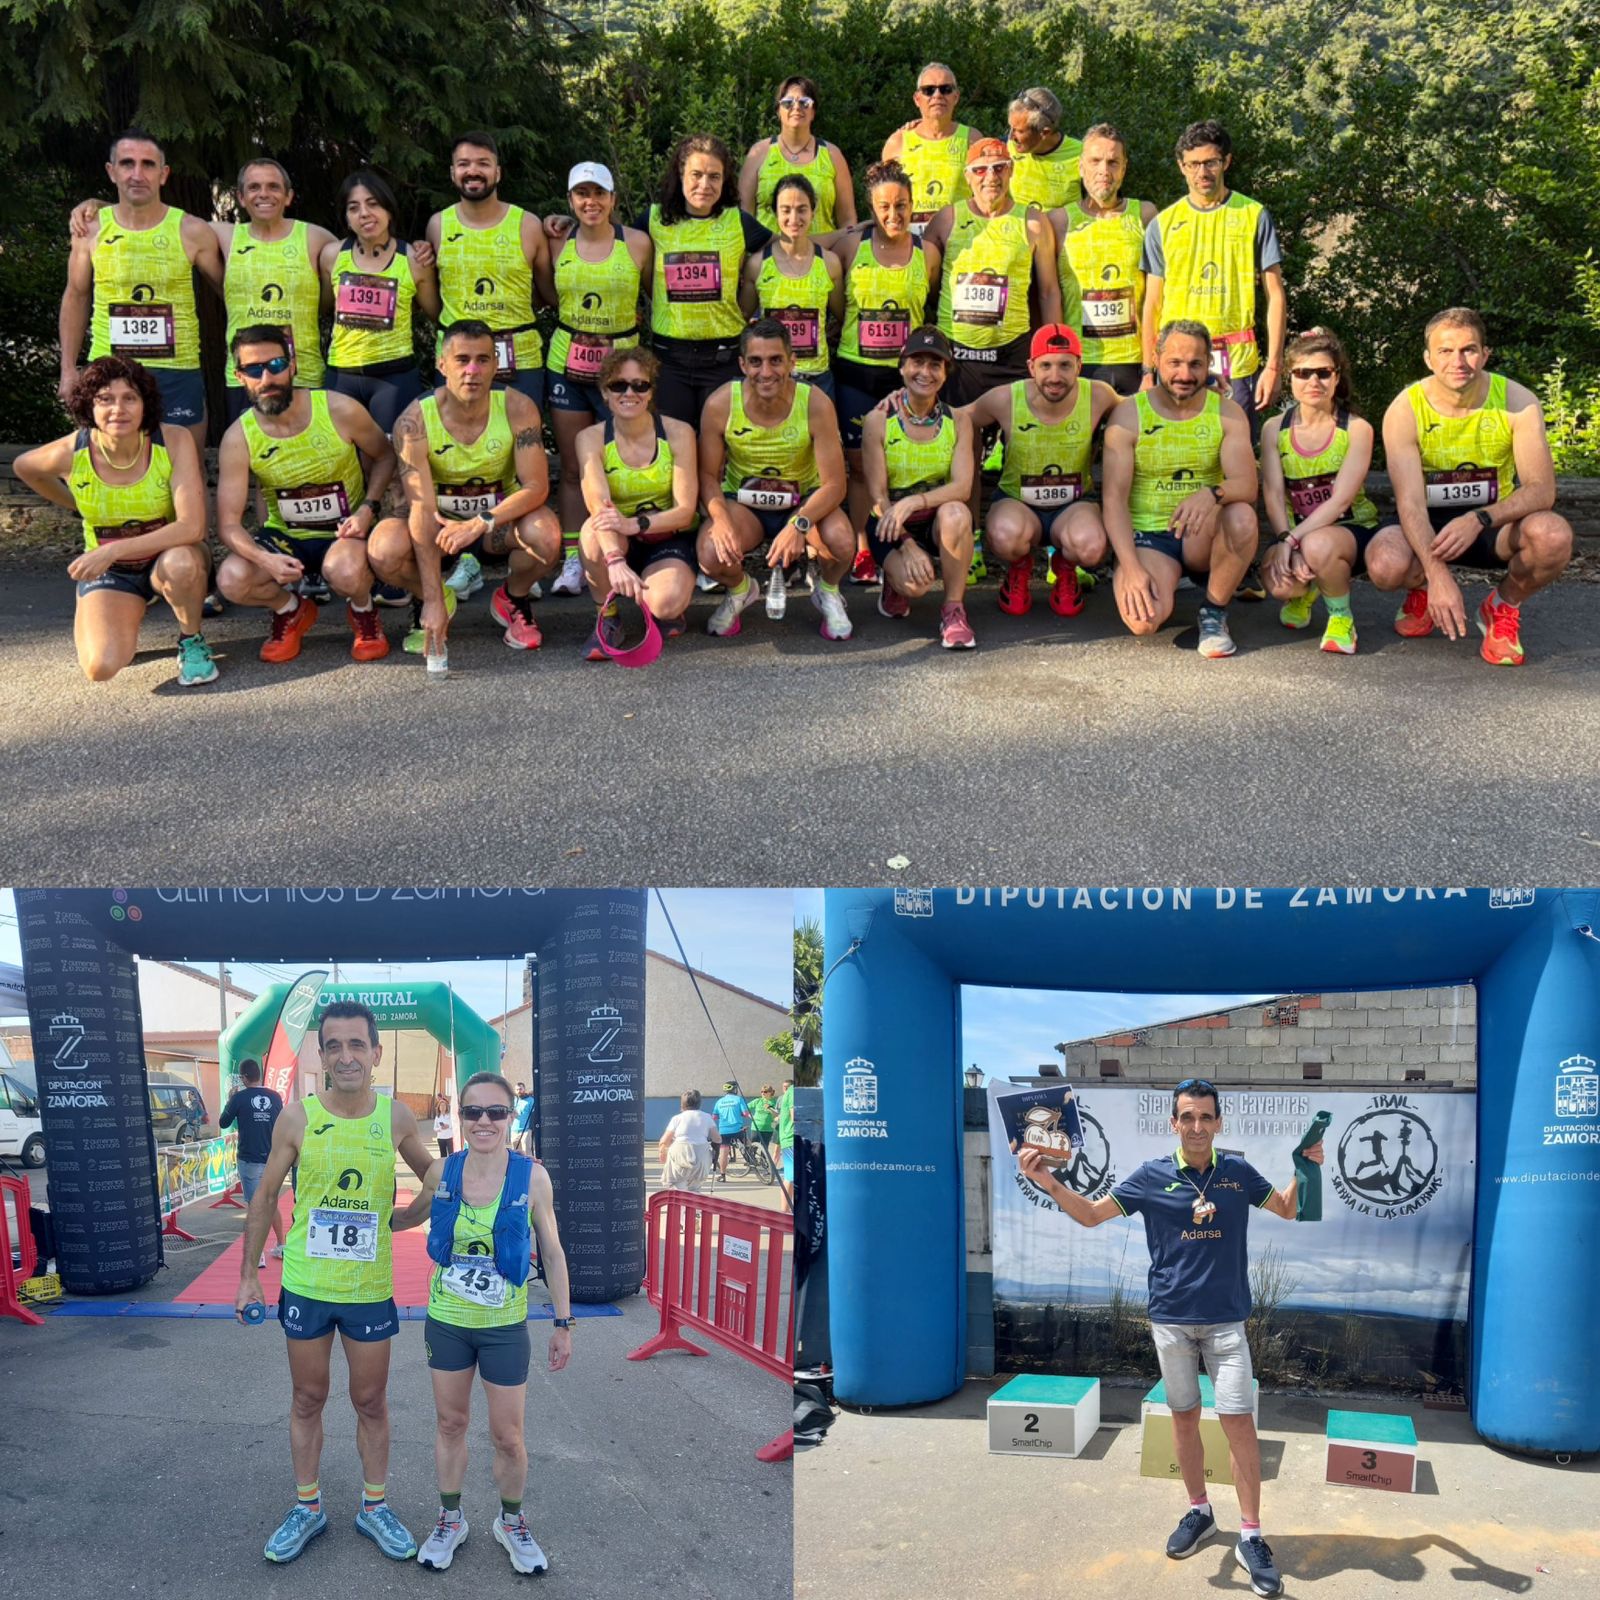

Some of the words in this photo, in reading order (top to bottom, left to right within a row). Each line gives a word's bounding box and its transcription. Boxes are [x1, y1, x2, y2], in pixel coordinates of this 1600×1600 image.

[676, 266, 708, 281] 1394
[348, 289, 382, 305] 1391
[964, 287, 994, 301] 1388
[463, 300, 505, 311] Adarsa
[1093, 302, 1124, 317] 1392
[247, 307, 292, 320] Adarsa
[570, 313, 610, 327] Adarsa
[122, 320, 158, 335] 1382
[868, 323, 898, 338] 6151
[574, 347, 603, 362] 1400
[751, 493, 785, 506] 1387
[1035, 488, 1068, 500] 1386
[1296, 488, 1332, 507] 1398
[1441, 484, 1481, 501] 1395
[293, 498, 332, 514] 1378
[453, 498, 489, 512] 1379
[1216, 887, 1264, 910] DE
[358, 991, 417, 1007] RURAL
[390, 1012, 417, 1021] ZAMORA
[47, 1095, 108, 1108] ZAMORA
[573, 1089, 634, 1103] ZAMORA
[1139, 1092, 1173, 1115] Sier
[1220, 1097, 1234, 1115] as
[1239, 1093, 1308, 1115] Cavernas
[1372, 1094, 1412, 1109] TRAIL
[837, 1127, 888, 1138] ZAMORA
[1239, 1118, 1309, 1136] Valverde
[1544, 1123, 1595, 1133] DIPUTACIÓN
[319, 1195, 369, 1210] Adarsa
[1331, 1175, 1357, 1210] SIERRA
[1358, 1203, 1372, 1215] DE
[1375, 1207, 1397, 1220] LAS
[1399, 1175, 1444, 1216] CAVERNAS
[328, 1223, 358, 1246] 18
[1180, 1229, 1222, 1240] Adarsa
[460, 1268, 490, 1291] 45
[465, 1289, 478, 1297] CRIS
[1024, 1413, 1039, 1433] 2
[1012, 1438, 1053, 1449] SmartChip
[1361, 1451, 1377, 1470] 3
[1346, 1470, 1392, 1486] SmartChip
